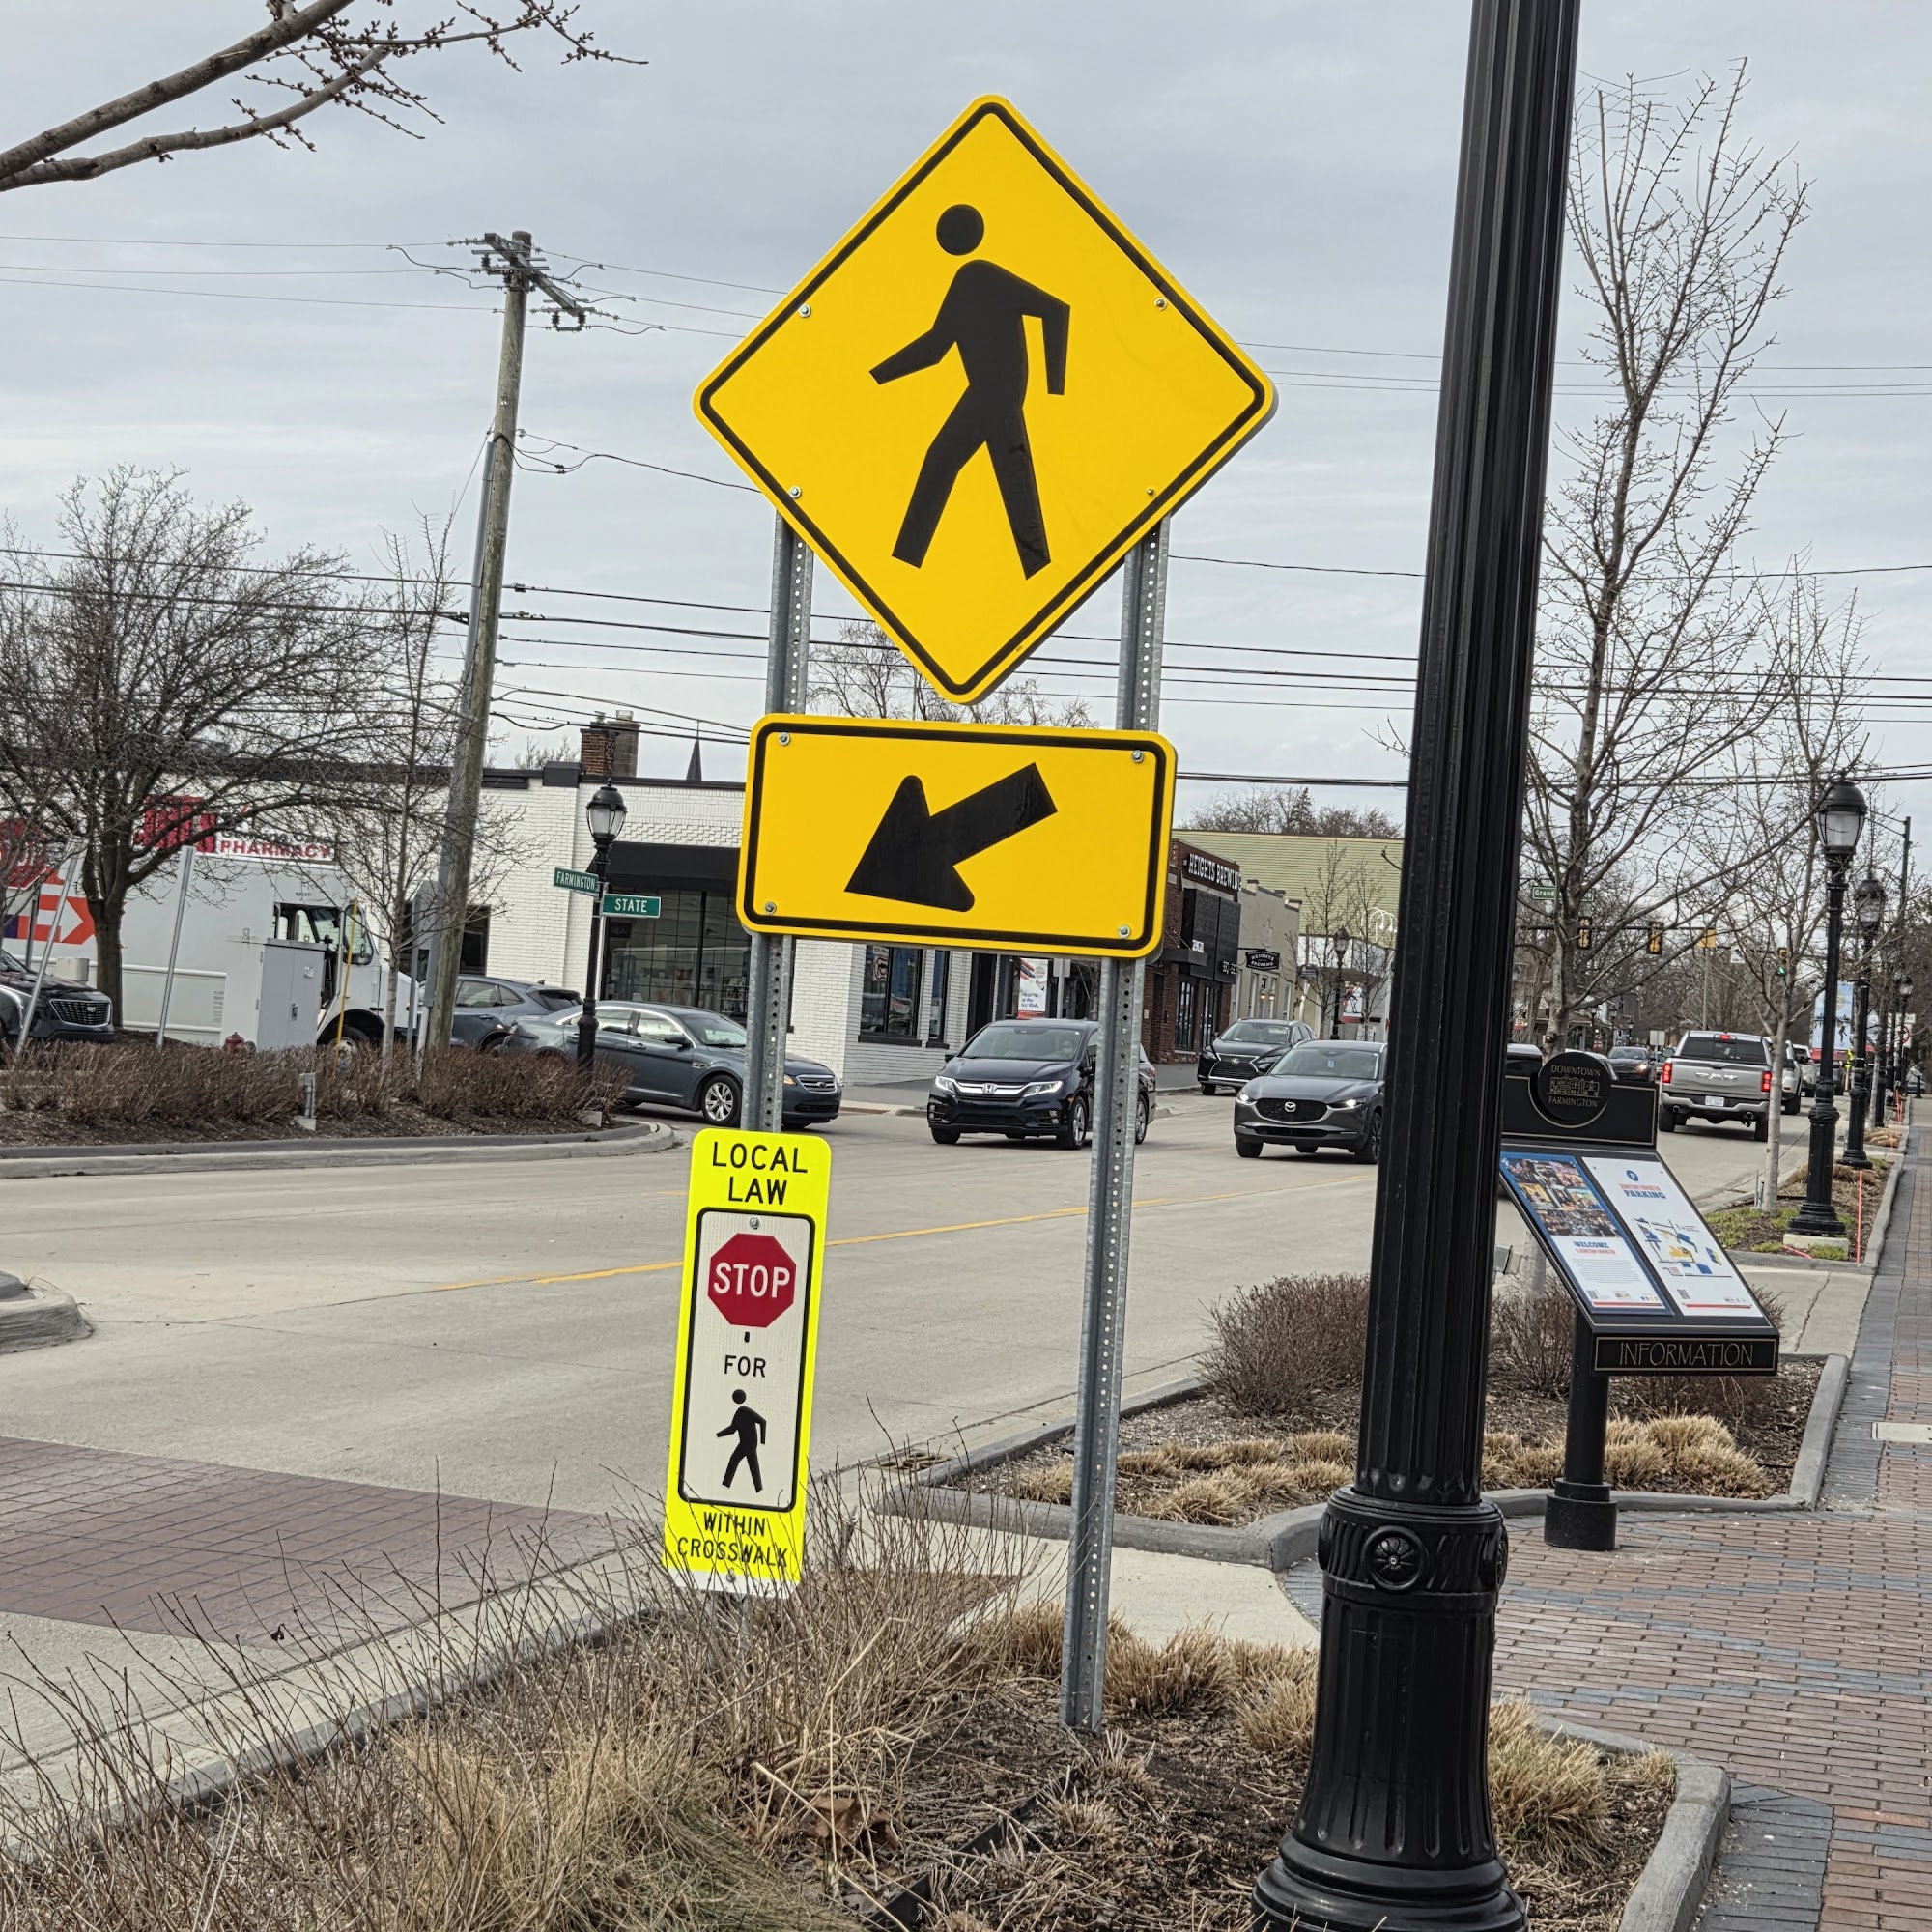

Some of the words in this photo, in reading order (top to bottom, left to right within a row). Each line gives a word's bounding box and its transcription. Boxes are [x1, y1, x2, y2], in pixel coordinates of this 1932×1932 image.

[220, 839, 329, 859] PHARMACY
[556, 871, 596, 890] FARMINGTON
[1188, 853, 1216, 881] HEIGHTS
[1216, 864, 1242, 891] BREWING
[614, 898, 647, 913] STATE
[1550, 1065, 1601, 1076] DOWNTOWN
[1548, 1095, 1598, 1108] FARMINGTON
[712, 1141, 809, 1174] LOCAL
[728, 1176, 788, 1206] LAW
[1623, 1189, 1667, 1199] PARKING
[1573, 1240, 1610, 1249] WELCOME
[713, 1262, 791, 1298] STOP
[724, 1354, 767, 1378] FOR
[1619, 1342, 1754, 1367] INFORMATION
[703, 1511, 766, 1537] WITHIN
[677, 1536, 788, 1568] CROSSWALK
